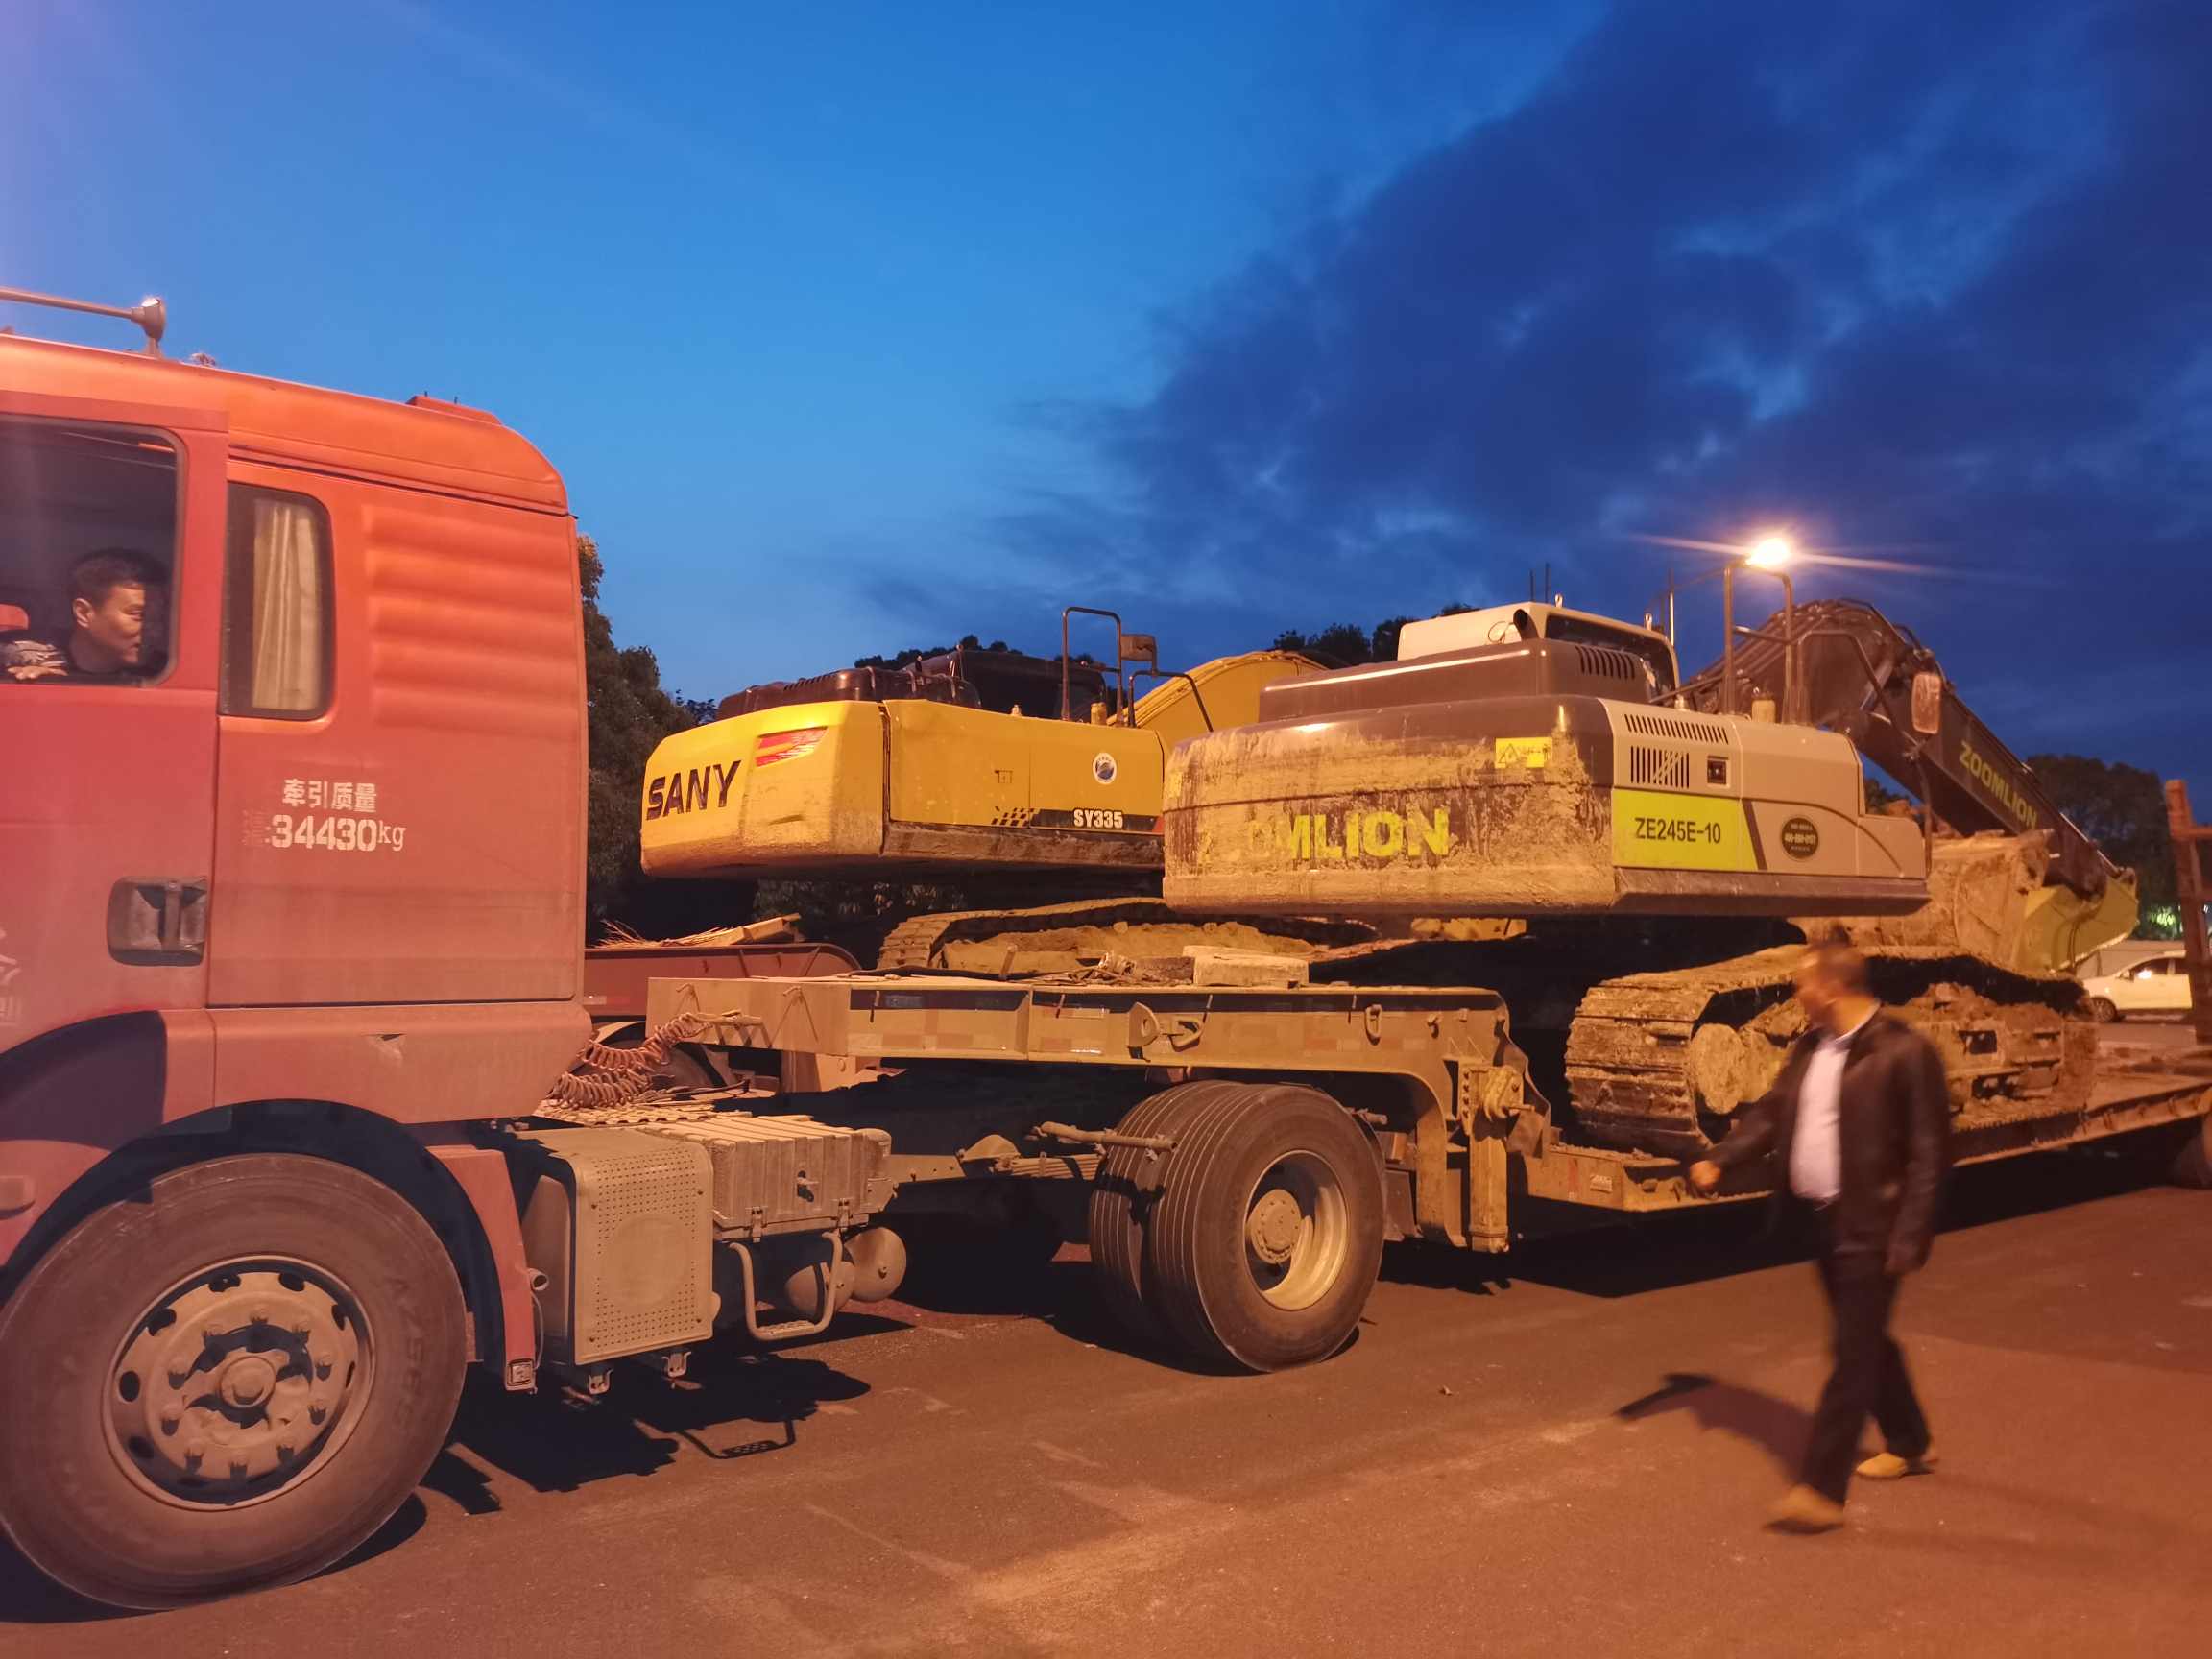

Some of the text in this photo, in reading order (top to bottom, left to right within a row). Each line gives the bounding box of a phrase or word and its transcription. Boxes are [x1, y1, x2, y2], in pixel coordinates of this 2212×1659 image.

[282, 778, 377, 813] 牵引质量
[645, 759, 742, 821] SANY
[1960, 740, 2037, 830] ZOOMLION
[1073, 807, 1123, 829] SY335
[1285, 807, 1450, 861] MLION
[1634, 817, 1721, 844] ZE245E-10
